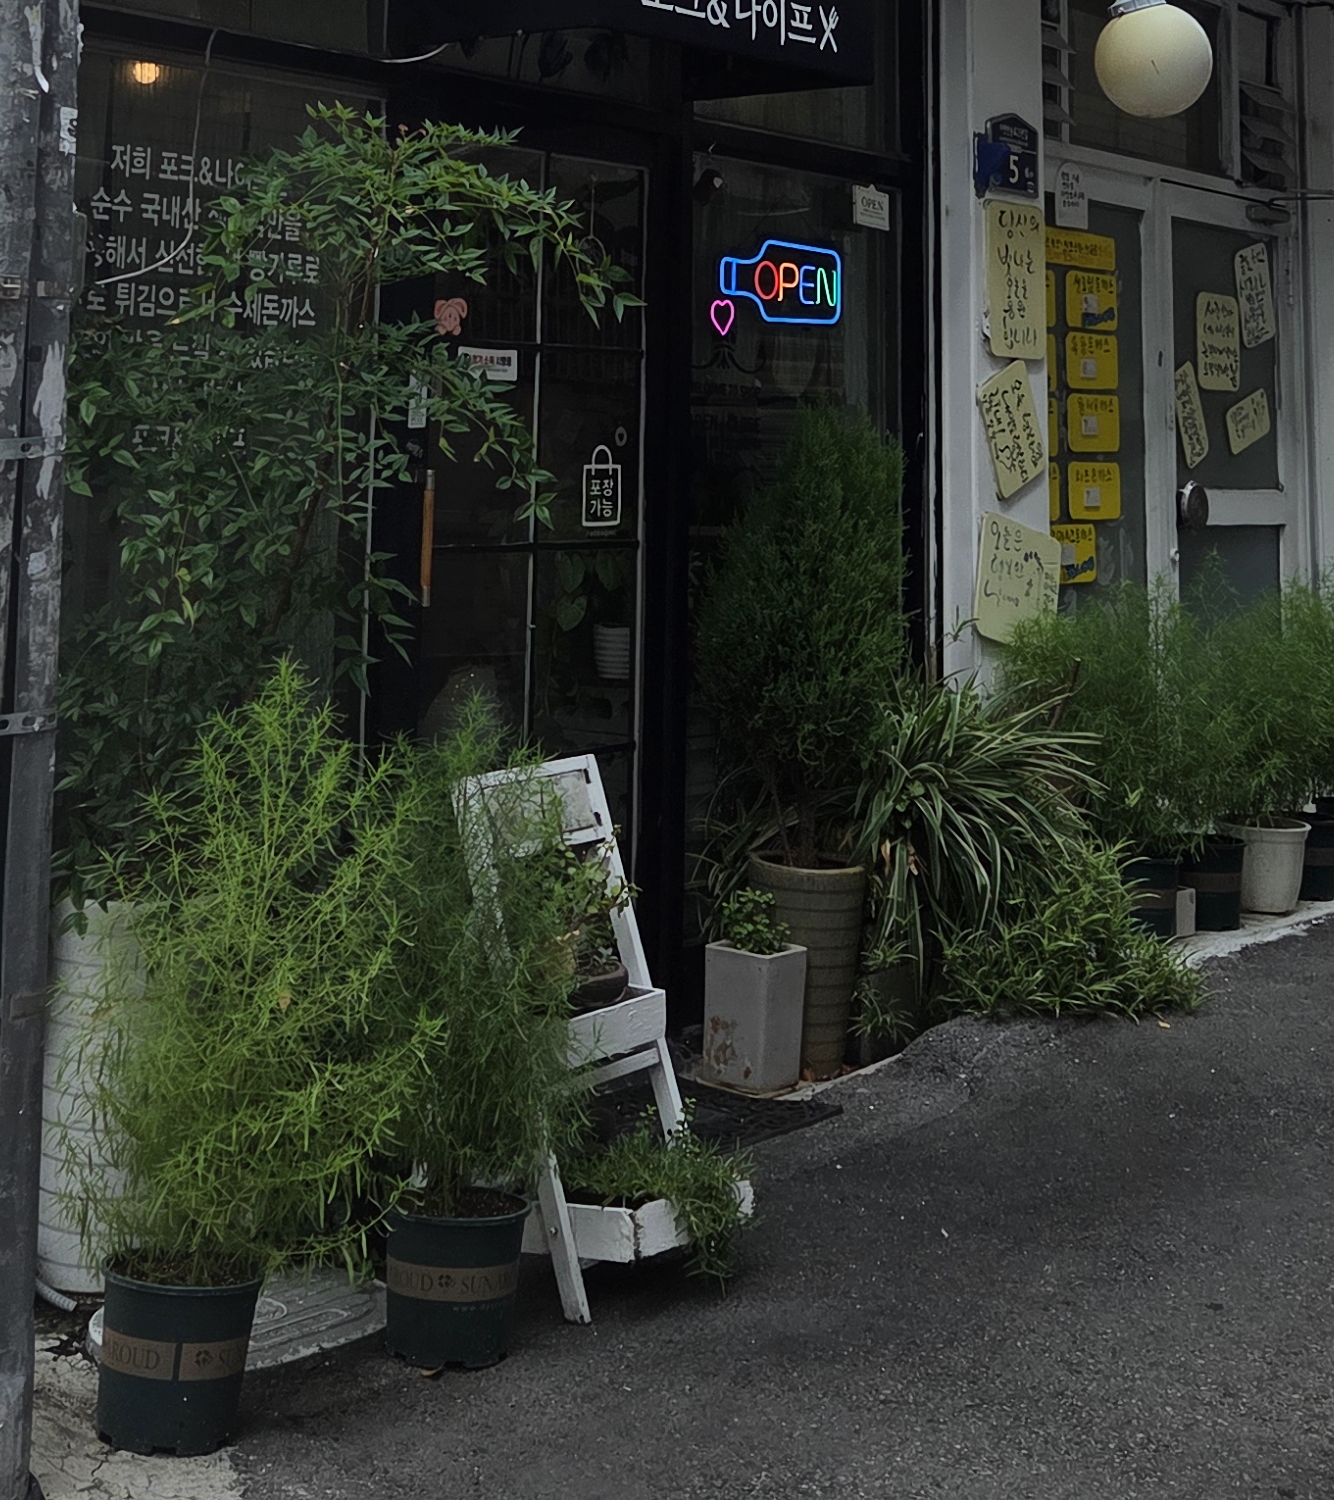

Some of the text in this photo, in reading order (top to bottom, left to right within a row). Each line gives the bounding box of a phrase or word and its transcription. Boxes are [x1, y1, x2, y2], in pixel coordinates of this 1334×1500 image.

[111, 144, 152, 180] 저희
[1008, 154, 1019, 184] 5
[90, 186, 133, 223] 순수
[140, 192, 202, 230] 국내산
[754, 260, 838, 307] OPEN
[589, 478, 615, 497] 포장
[589, 498, 615, 518] 가능
